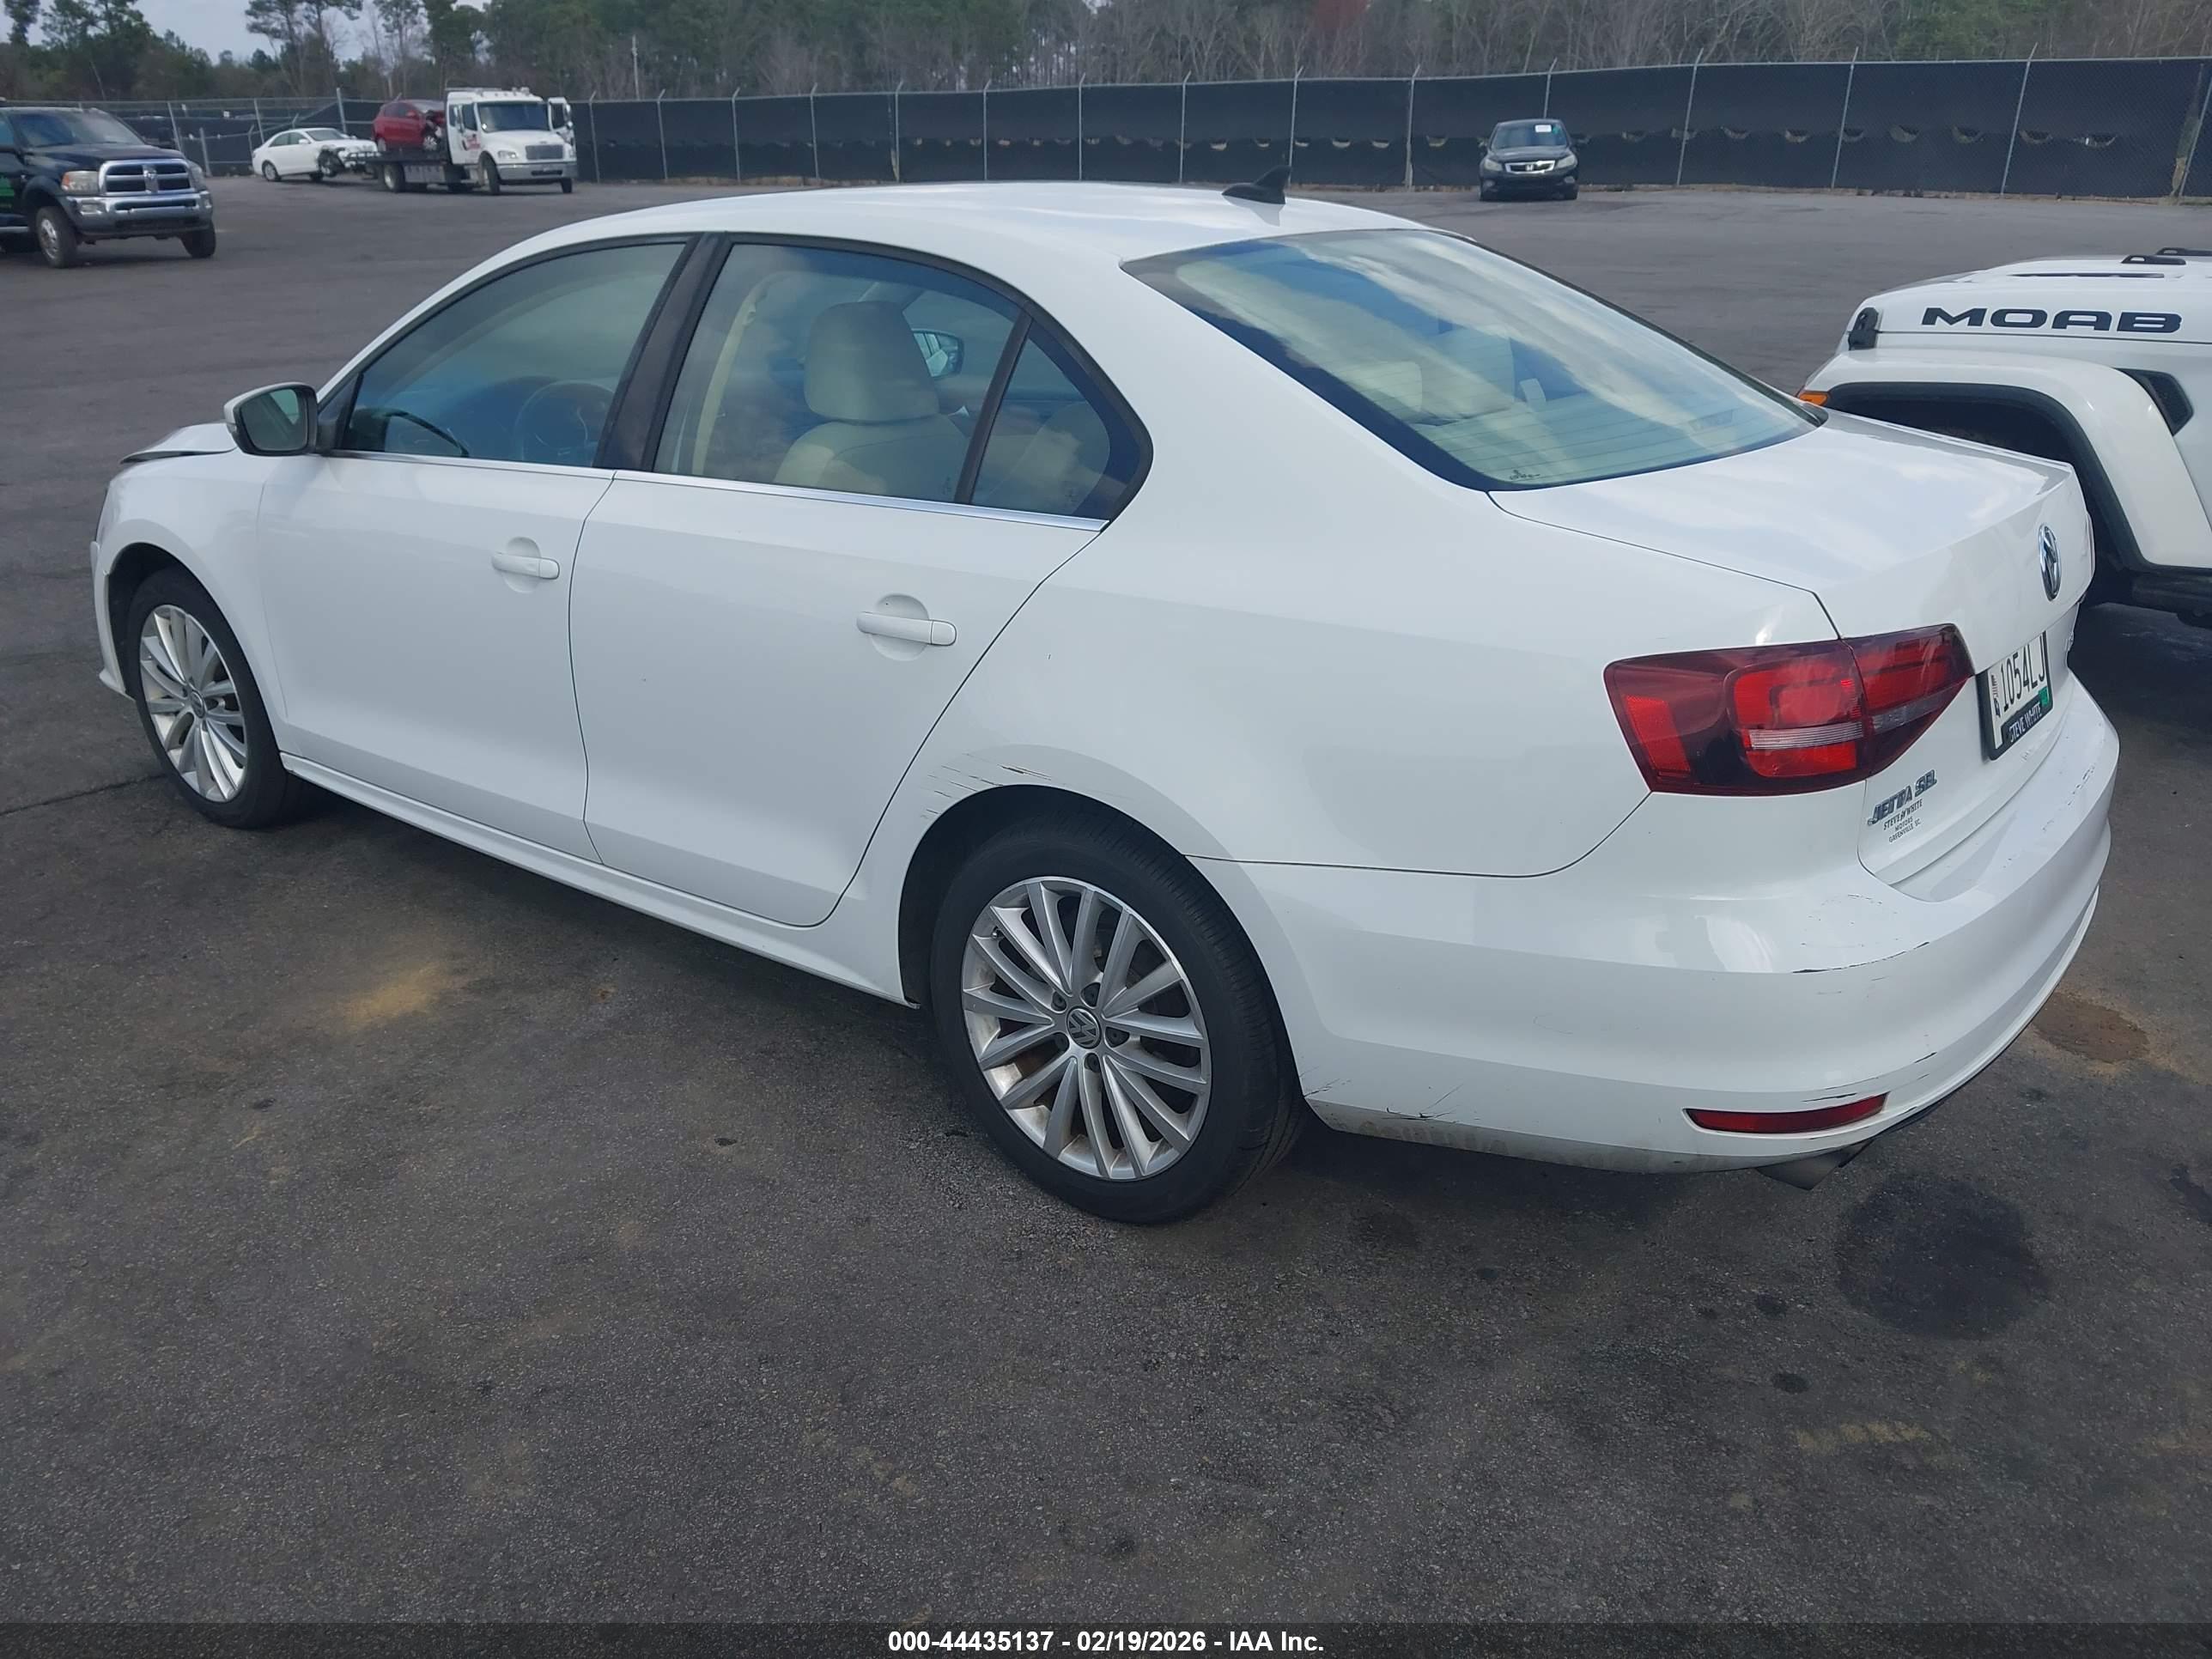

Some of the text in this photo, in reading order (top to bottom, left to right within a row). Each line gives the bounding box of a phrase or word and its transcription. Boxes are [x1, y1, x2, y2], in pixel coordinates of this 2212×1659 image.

[1921, 307, 2183, 333] MOAB
[2008, 702, 2042, 743] STEVE WHITE
[1868, 769, 1938, 826] JETTA SEL
[1883, 799, 1923, 830] STEVE WHITE
[1894, 816, 1913, 831] MOTORS
